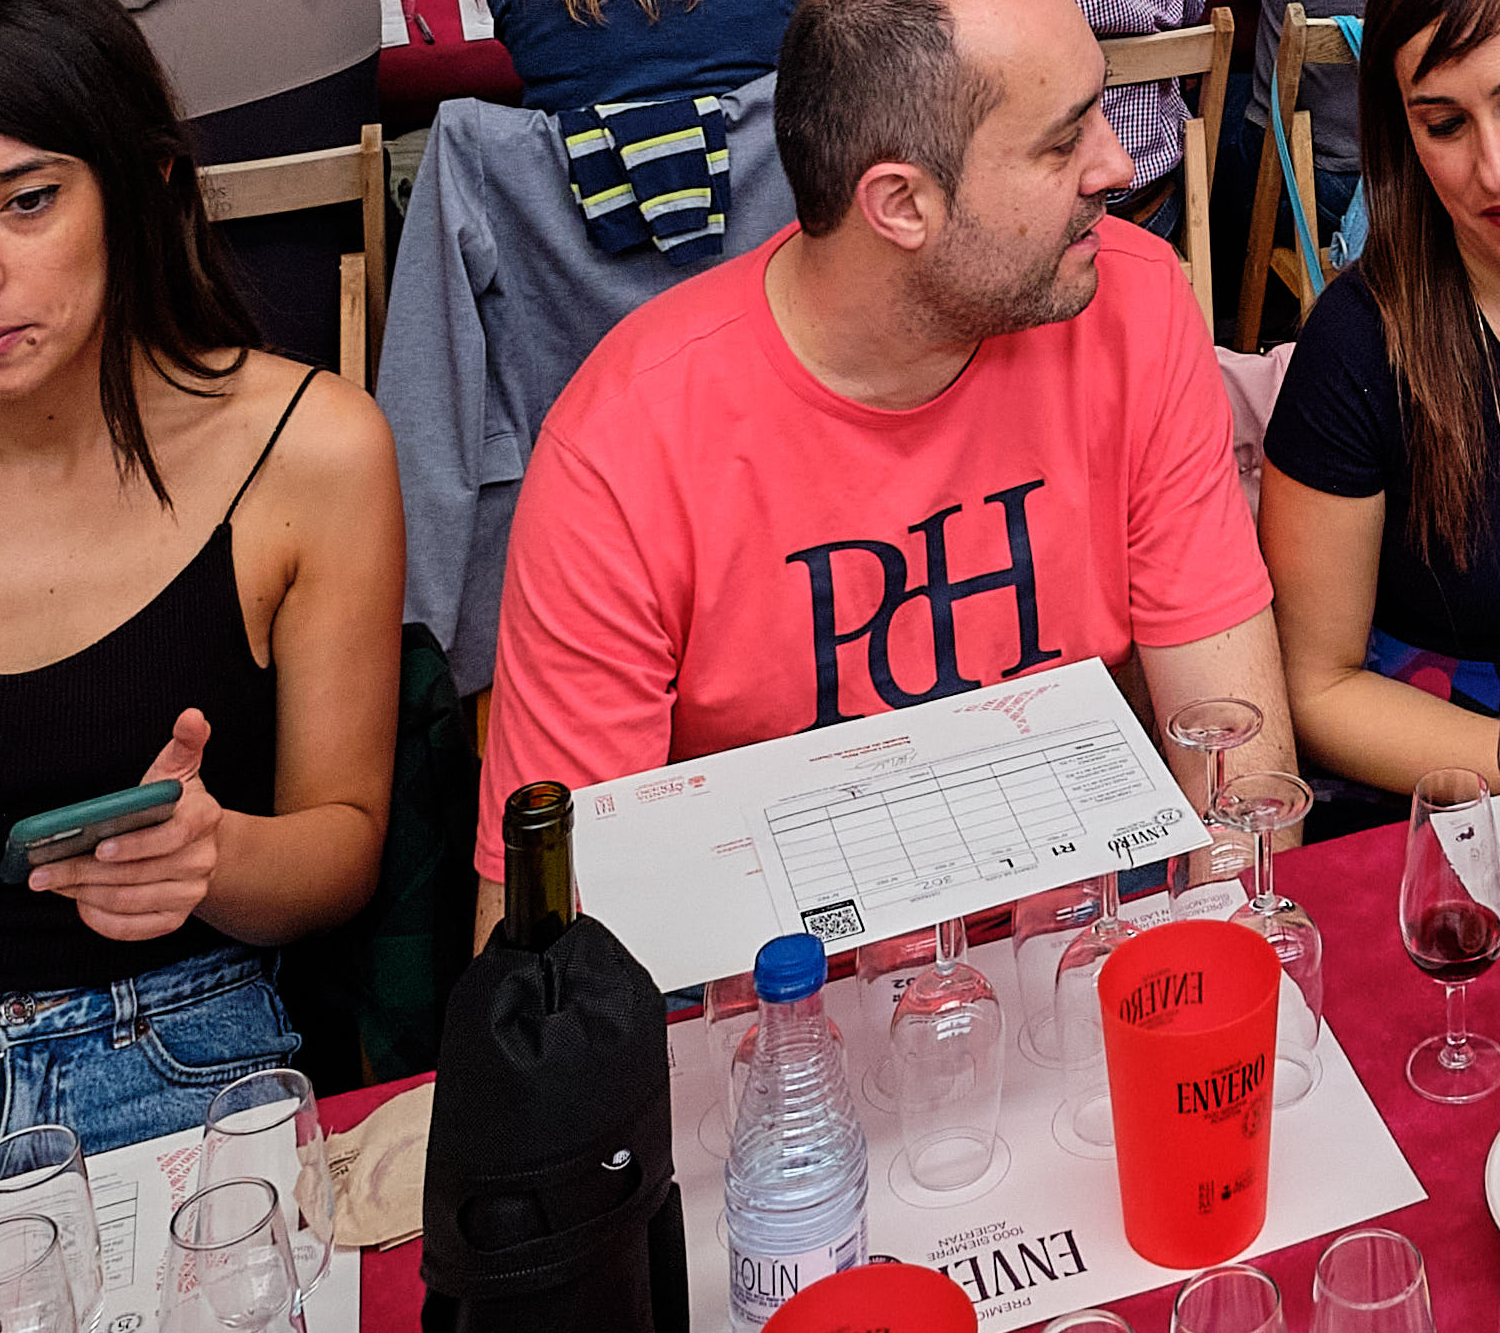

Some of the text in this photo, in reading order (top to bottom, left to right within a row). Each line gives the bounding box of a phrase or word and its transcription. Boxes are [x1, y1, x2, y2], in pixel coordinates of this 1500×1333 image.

[1001, 858, 1014, 869] L
[1052, 842, 1077, 857] R1
[1176, 1052, 1266, 1115] ENVERO
[927, 1224, 1024, 1262] 1000 SIEMPRE
[938, 1220, 1007, 1248] ACIERTAN
[940, 1229, 1088, 1304] ENVE
